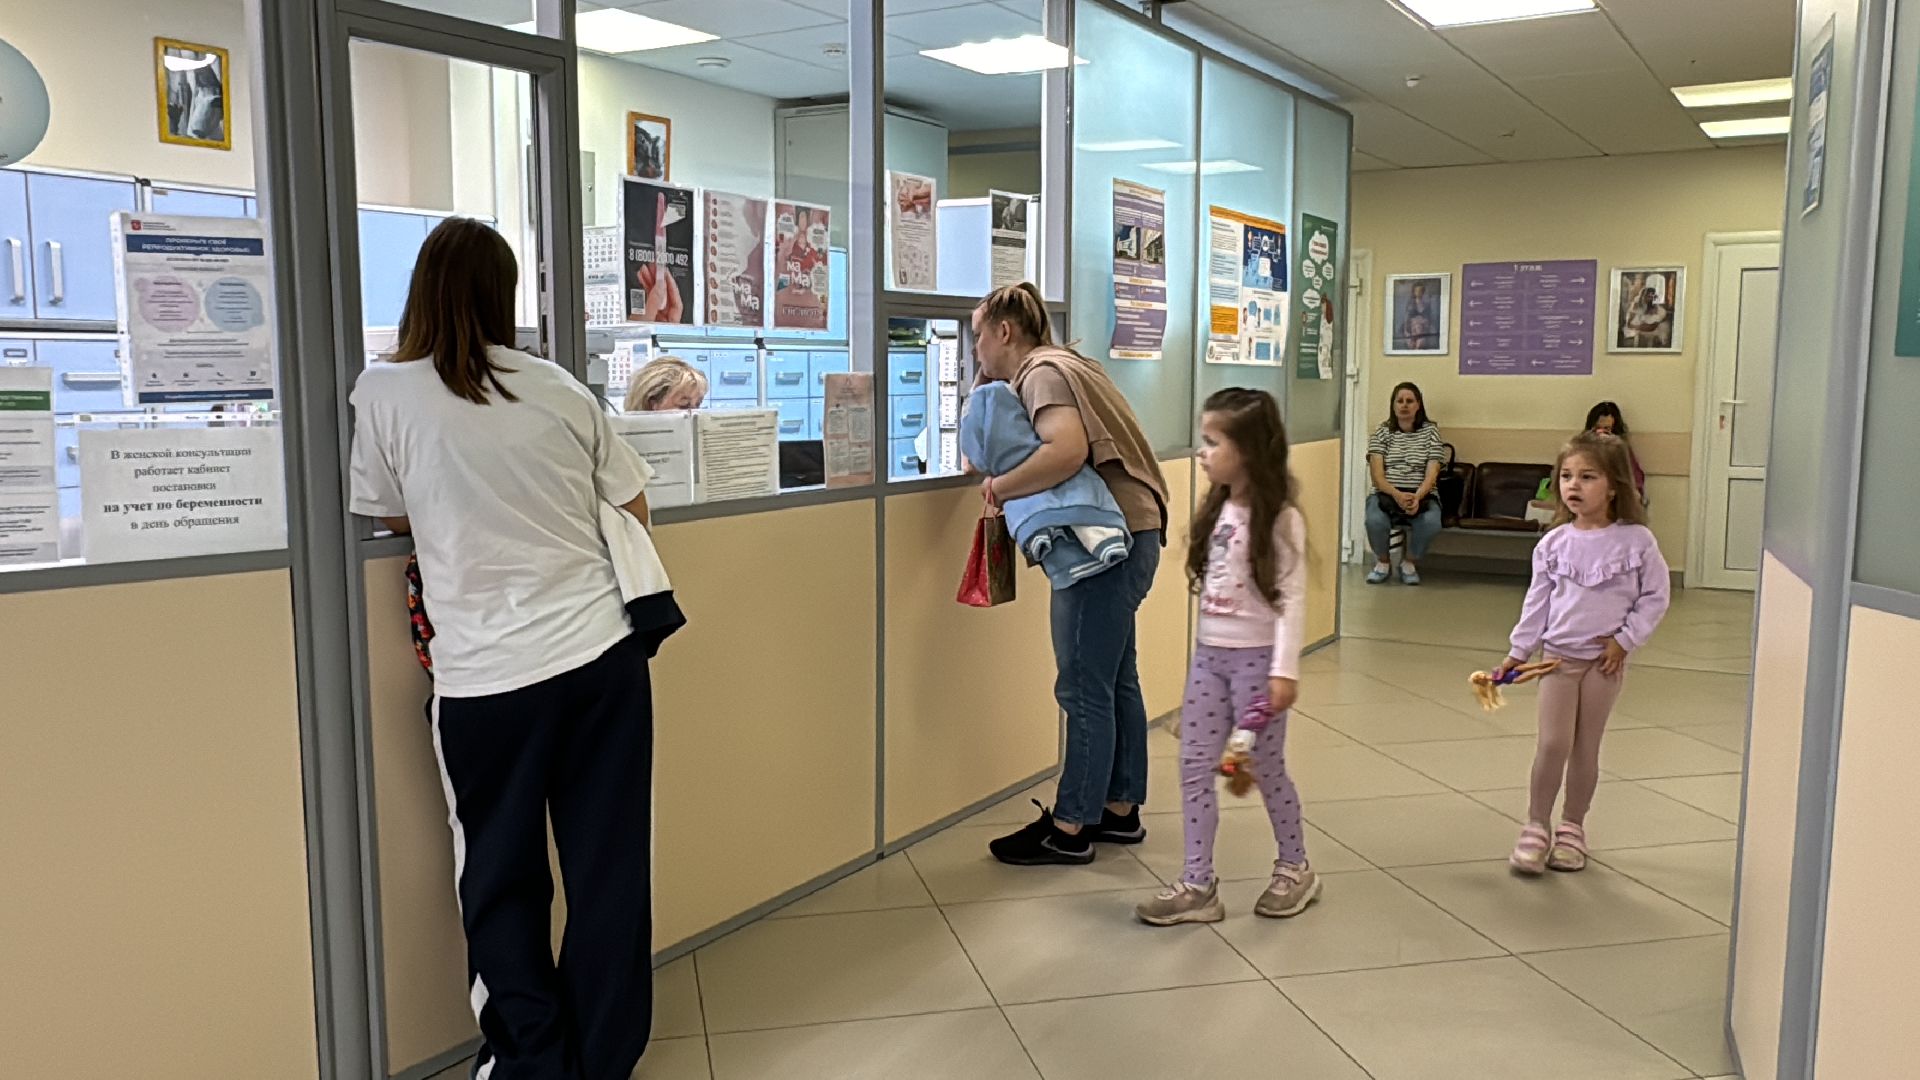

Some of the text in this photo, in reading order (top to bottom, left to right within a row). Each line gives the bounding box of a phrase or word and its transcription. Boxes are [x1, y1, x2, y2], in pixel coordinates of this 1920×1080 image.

[110, 447, 252, 460] В женской консультации
[134, 464, 231, 479] работает кабинет
[152, 481, 217, 493] постановки
[103, 497, 263, 515] на учет по беременности
[130, 515, 240, 530] в день обращения
